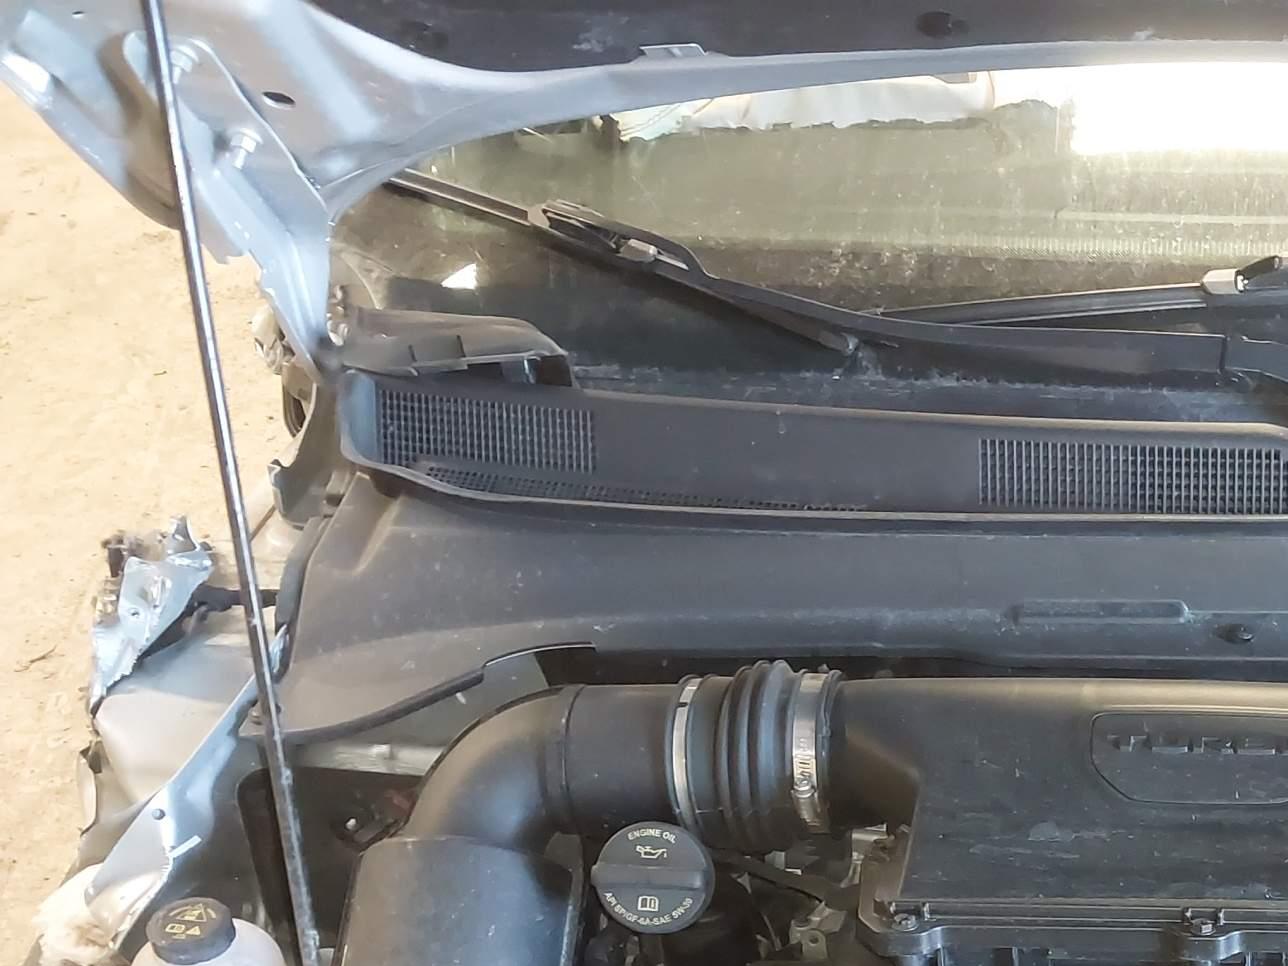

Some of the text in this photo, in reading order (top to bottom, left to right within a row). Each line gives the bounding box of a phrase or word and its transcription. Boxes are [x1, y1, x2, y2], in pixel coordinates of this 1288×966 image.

[627, 828, 677, 844] ENGINE OIL
[603, 892, 617, 907] API
